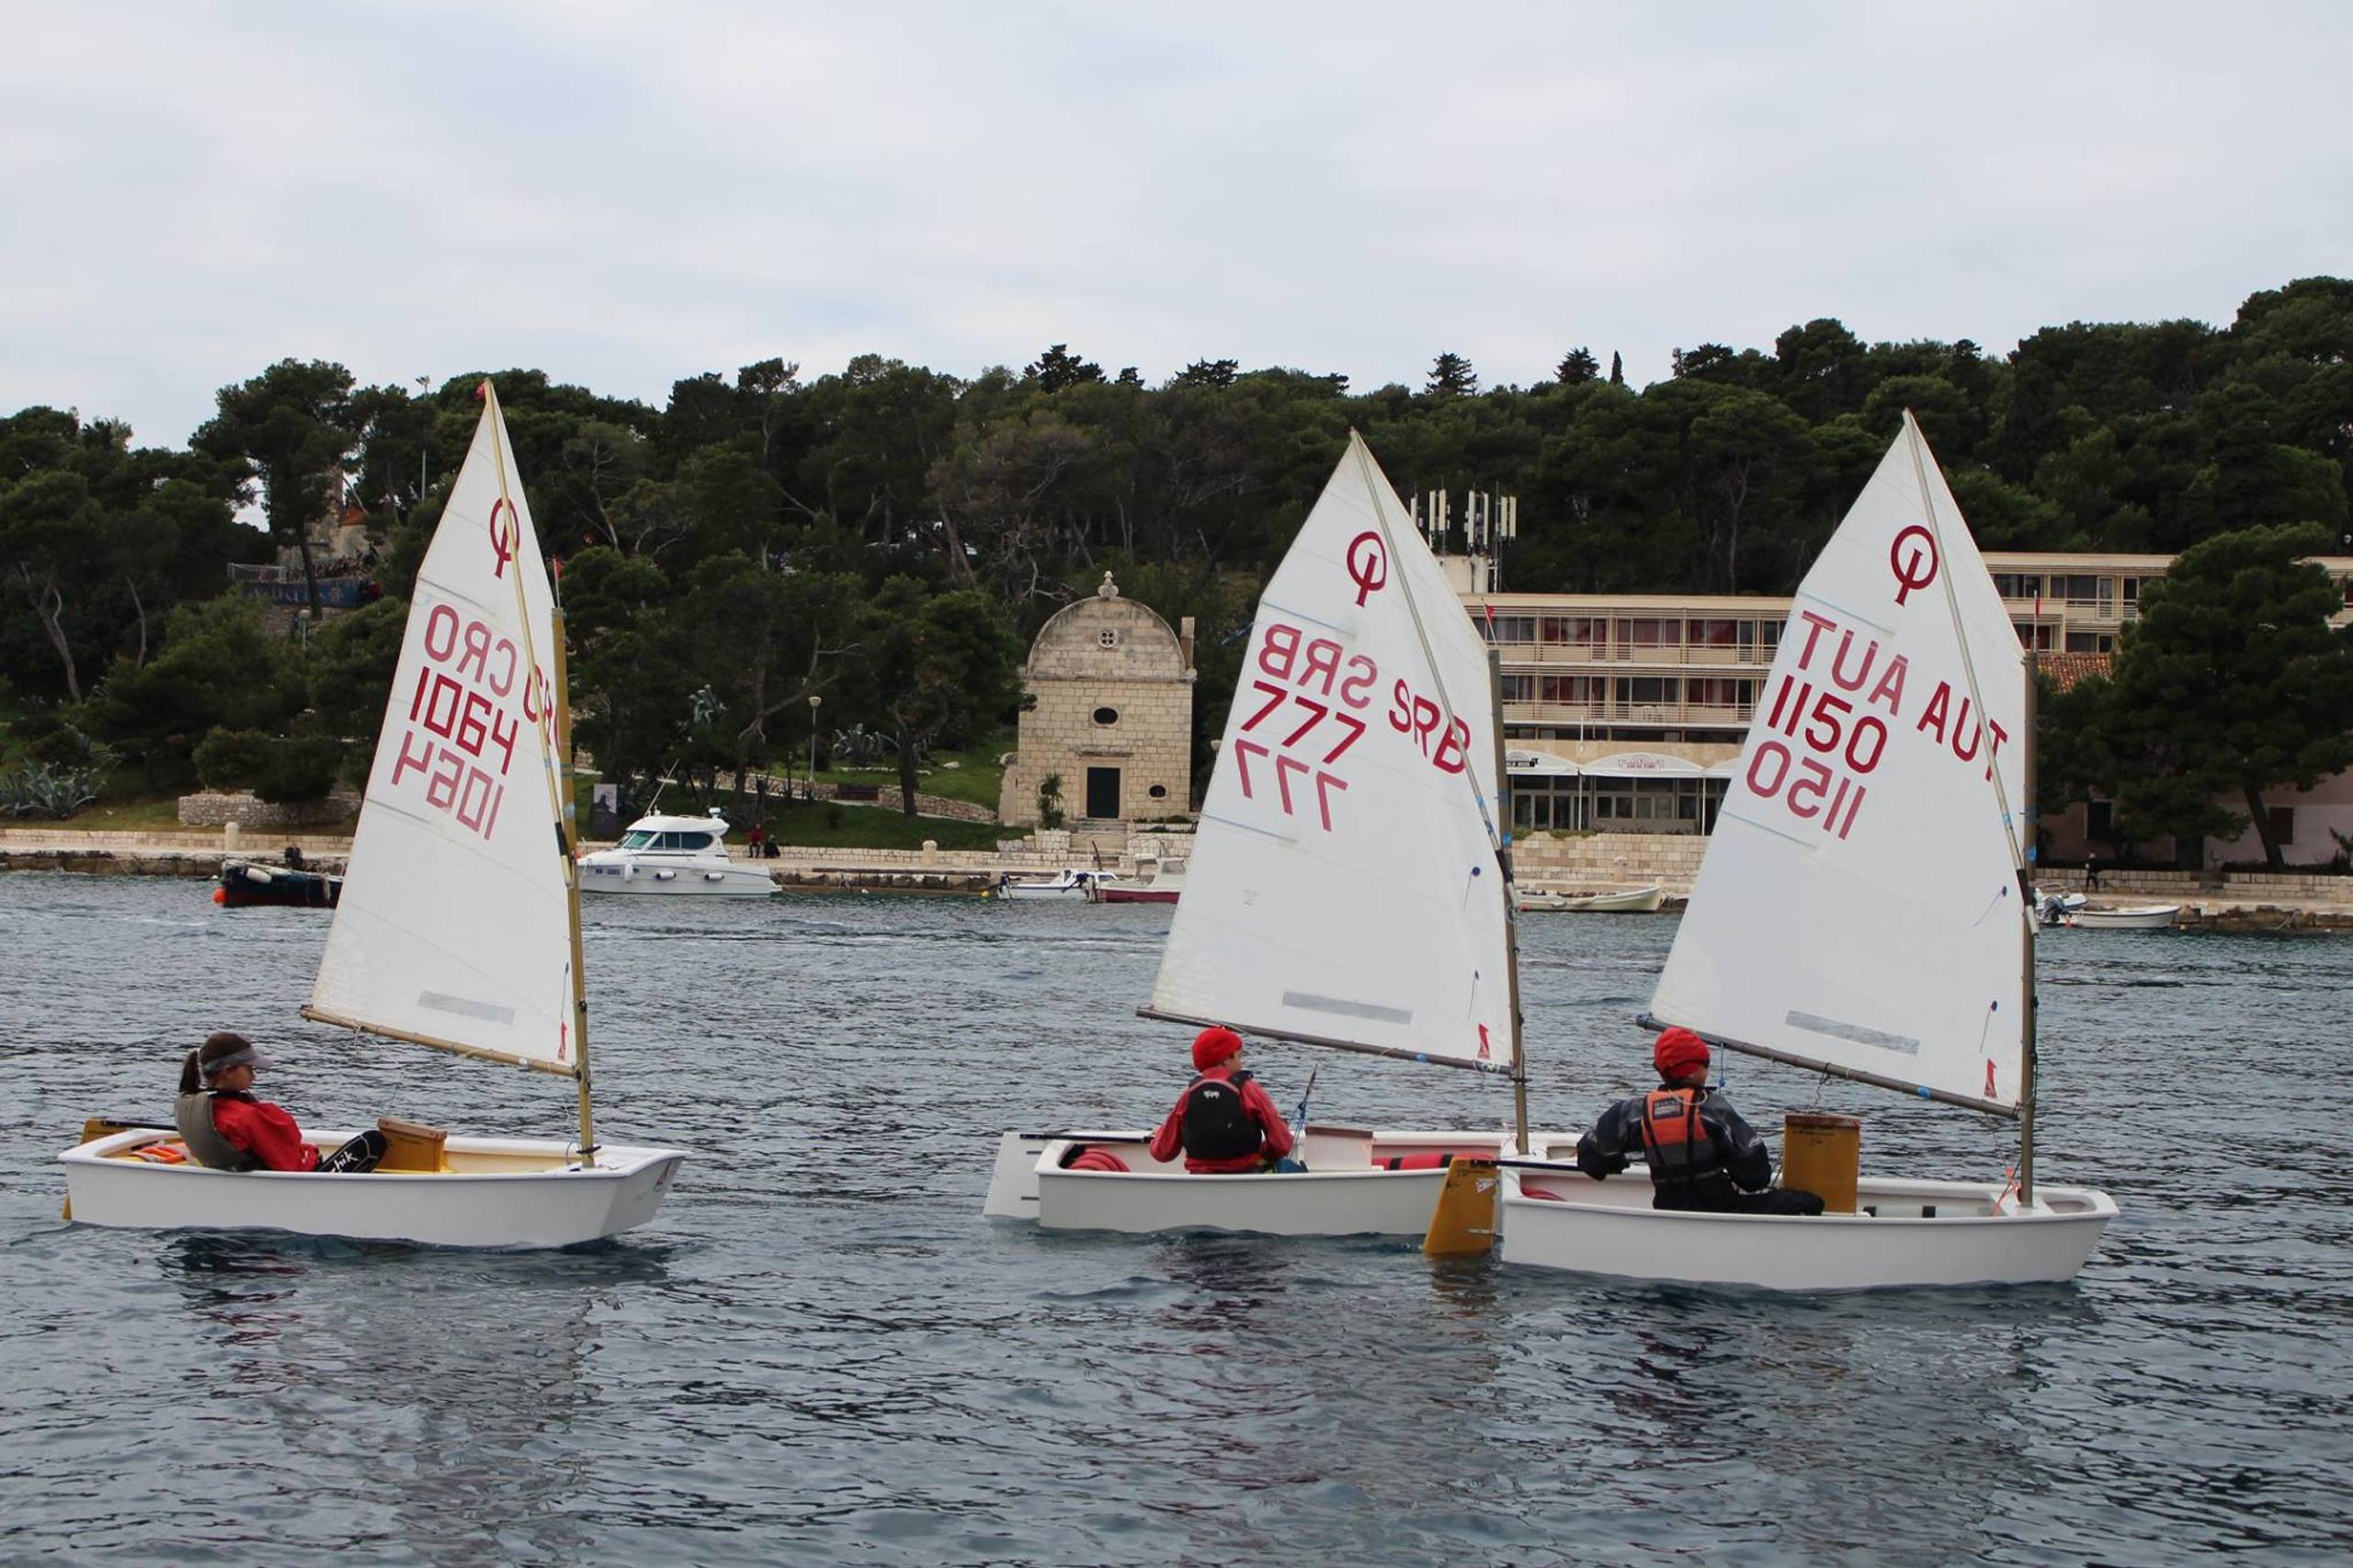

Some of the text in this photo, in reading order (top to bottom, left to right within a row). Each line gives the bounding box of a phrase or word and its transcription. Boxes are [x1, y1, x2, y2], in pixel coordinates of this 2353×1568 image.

[410, 665, 519, 776] 1064
[522, 665, 563, 757] CR
[1241, 678, 1367, 765] 777
[1388, 677, 1472, 775] SRB
[1768, 675, 1888, 775] 1150
[1915, 680, 2009, 782] AUT
